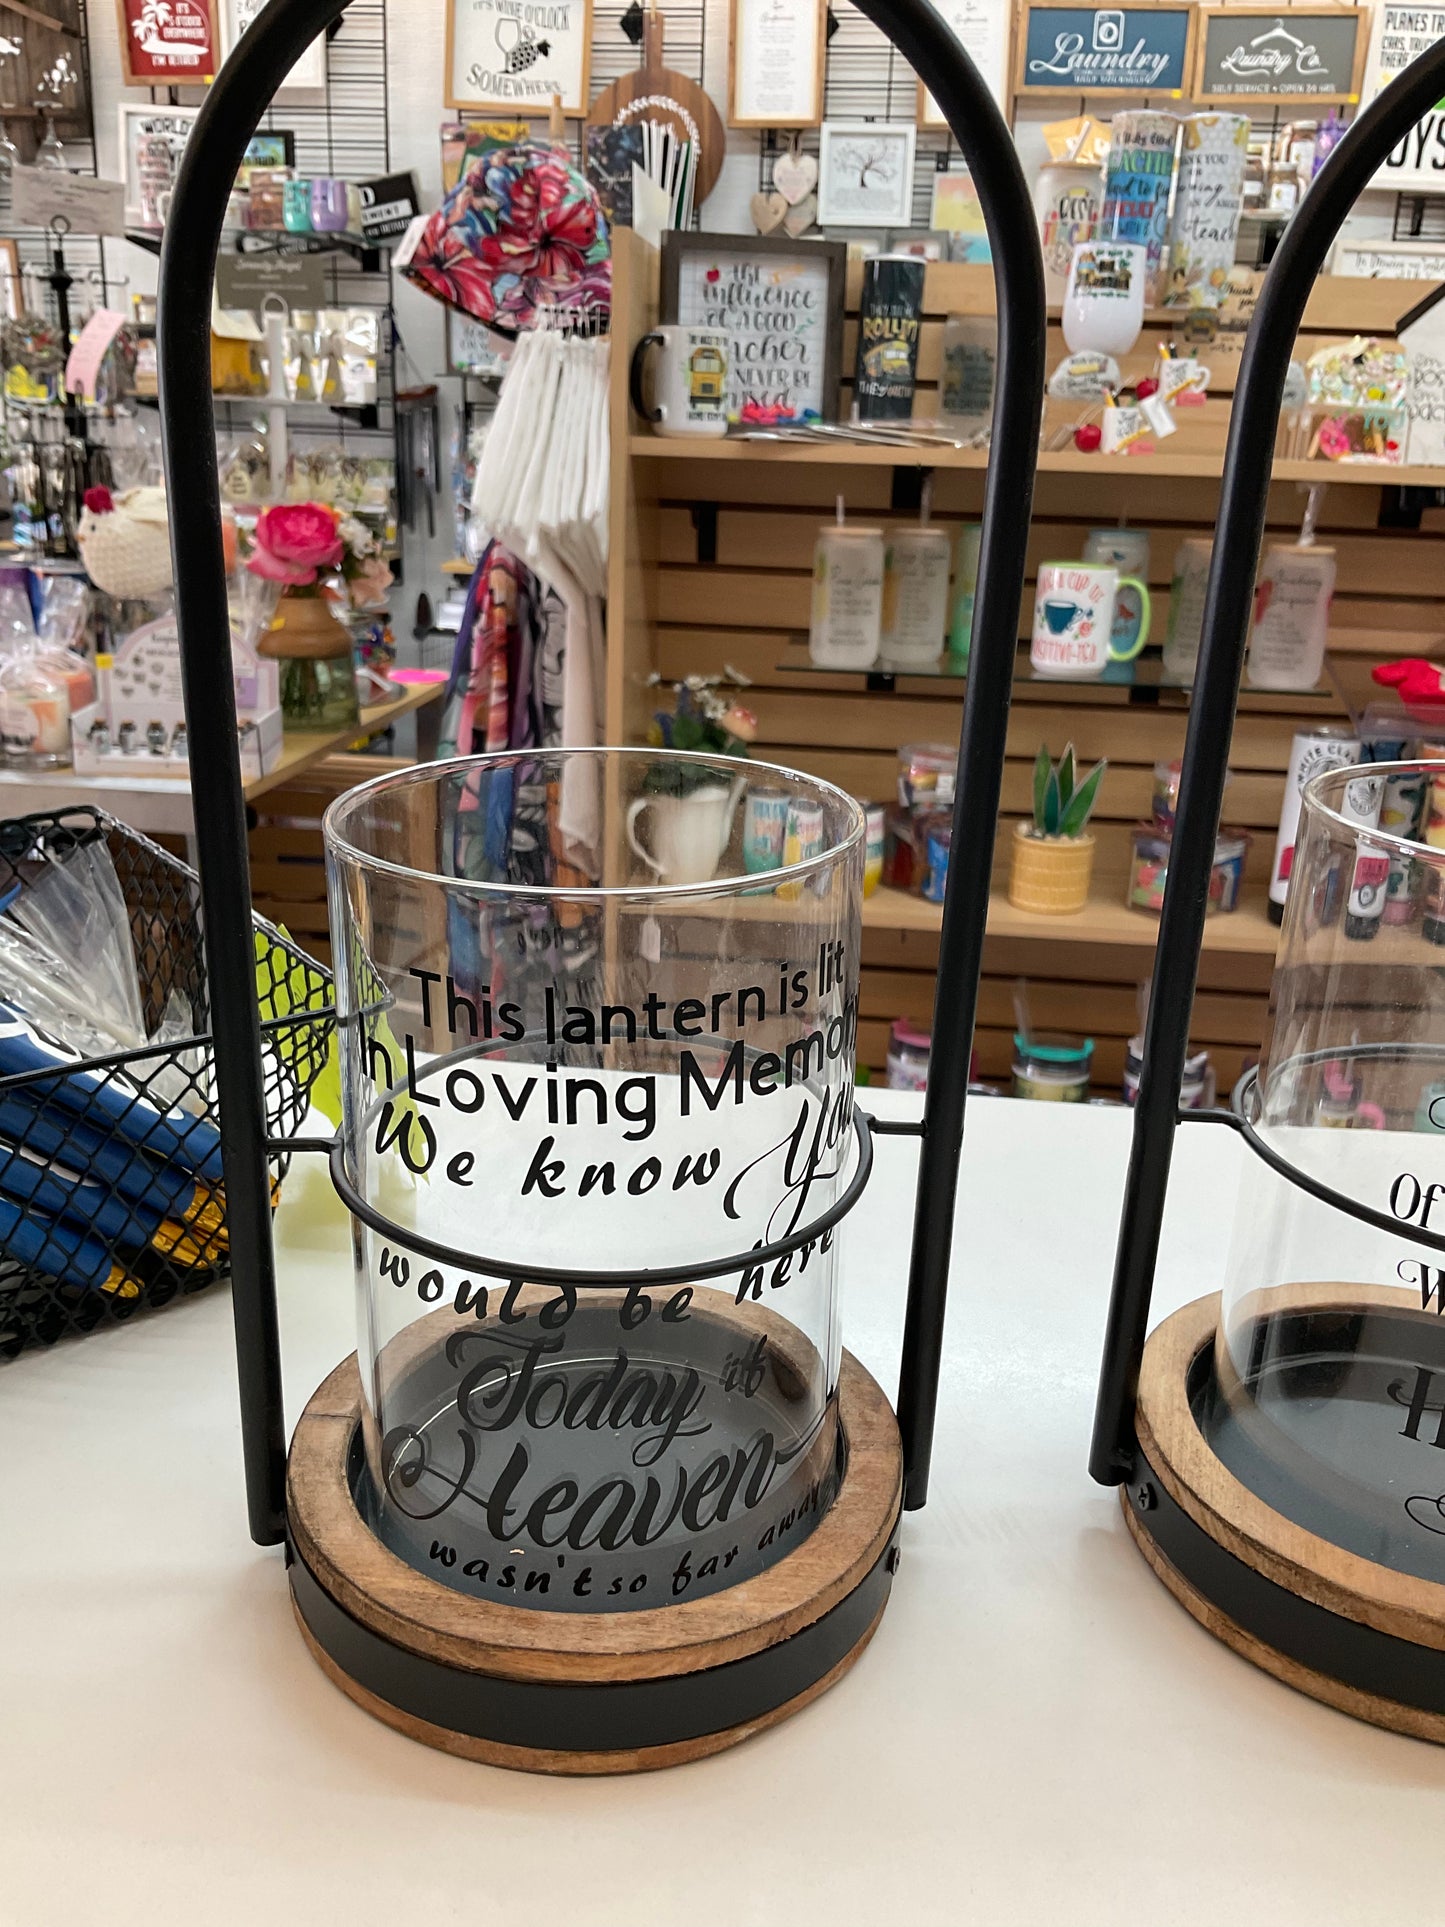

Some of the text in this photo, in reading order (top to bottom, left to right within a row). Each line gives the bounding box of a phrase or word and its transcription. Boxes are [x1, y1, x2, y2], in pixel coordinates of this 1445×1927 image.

[1029, 32, 1170, 84] Laundry
[1220, 46, 1293, 77] Laundry
[409, 940, 845, 1046] This lantern is lit
[359, 1011, 393, 1091] In
[406, 1032, 657, 1142] Loving
[374, 1101, 475, 1188] We
[521, 1134, 722, 1198] know
[379, 1227, 833, 1331] would be here
[445, 1330, 712, 1468] Today
[382, 1418, 815, 1553] Heaven
[429, 1478, 821, 1598] wasn't so far away
